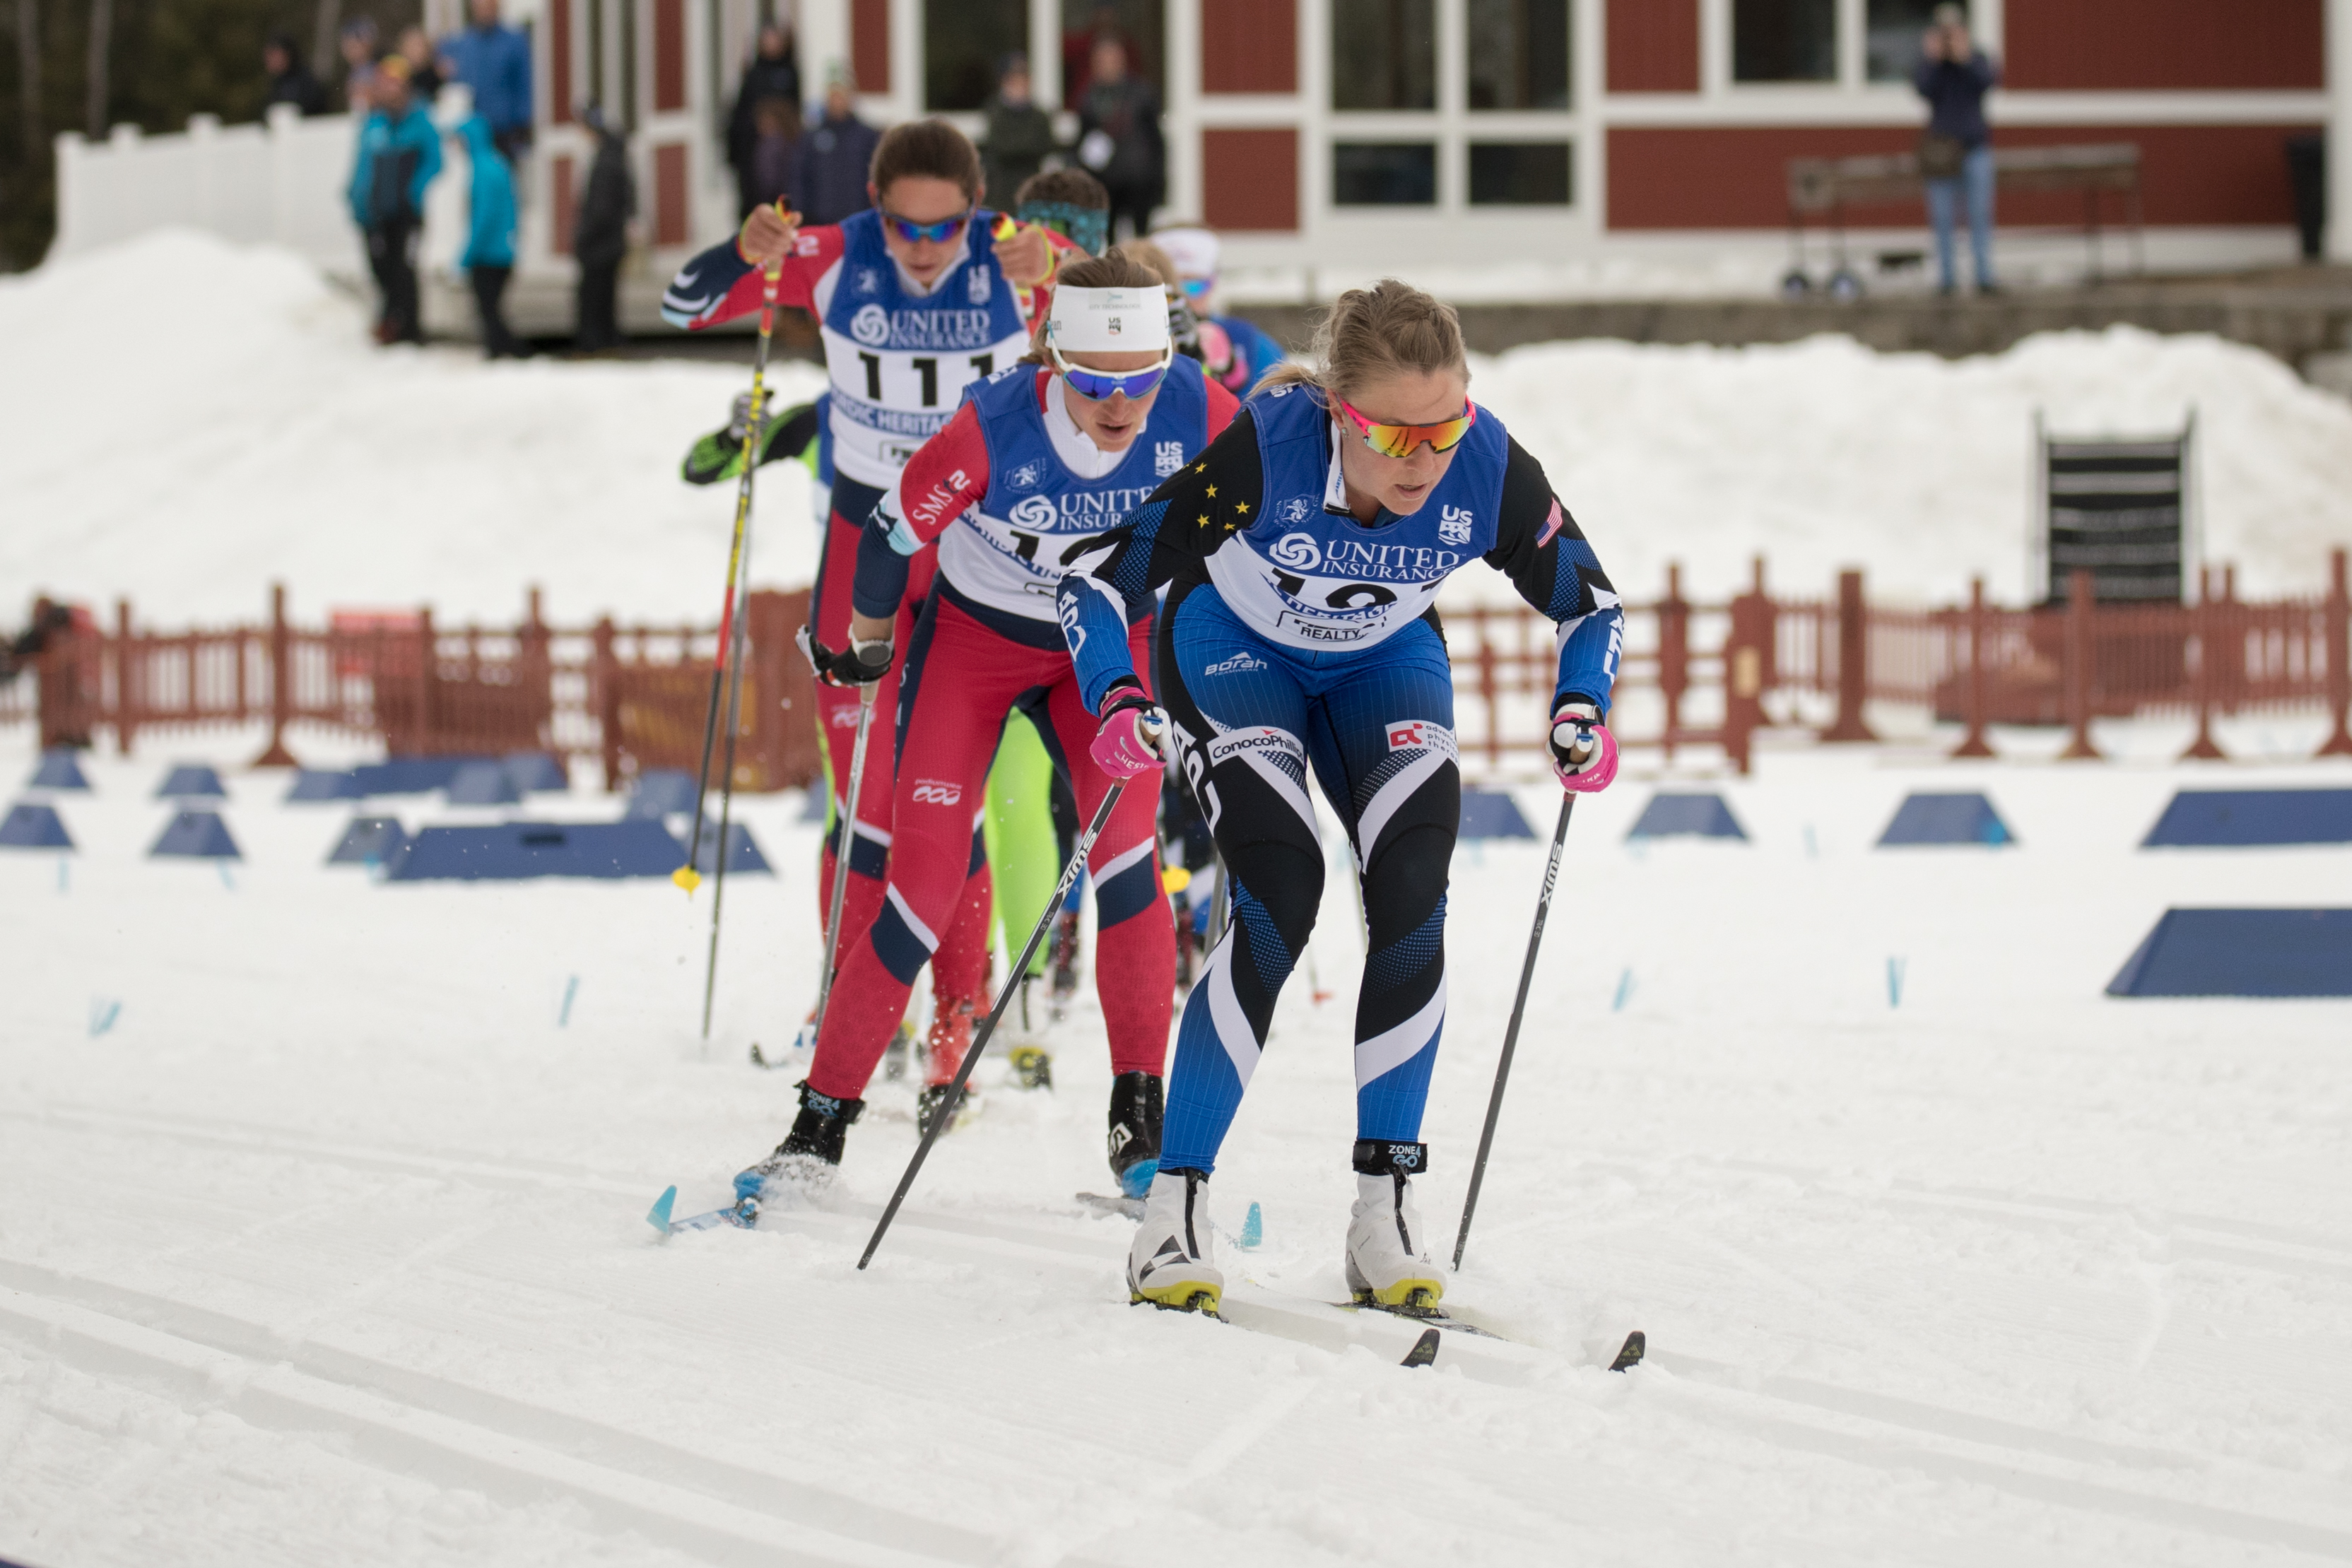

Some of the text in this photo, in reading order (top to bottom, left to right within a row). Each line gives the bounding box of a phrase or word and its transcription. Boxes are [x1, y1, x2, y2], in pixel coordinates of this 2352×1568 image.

[890, 309, 989, 334] UNITED
[889, 331, 989, 349] INSURANCE
[1156, 441, 1183, 456] US
[1060, 485, 1162, 517] UNITE
[1060, 512, 1122, 530] INSUR
[1442, 505, 1474, 527] US
[1327, 540, 1459, 570] UNITED
[1321, 560, 1455, 581] INSURANCE
[1300, 626, 1360, 640] REALTY
[1388, 1145, 1421, 1157] ZONE4
